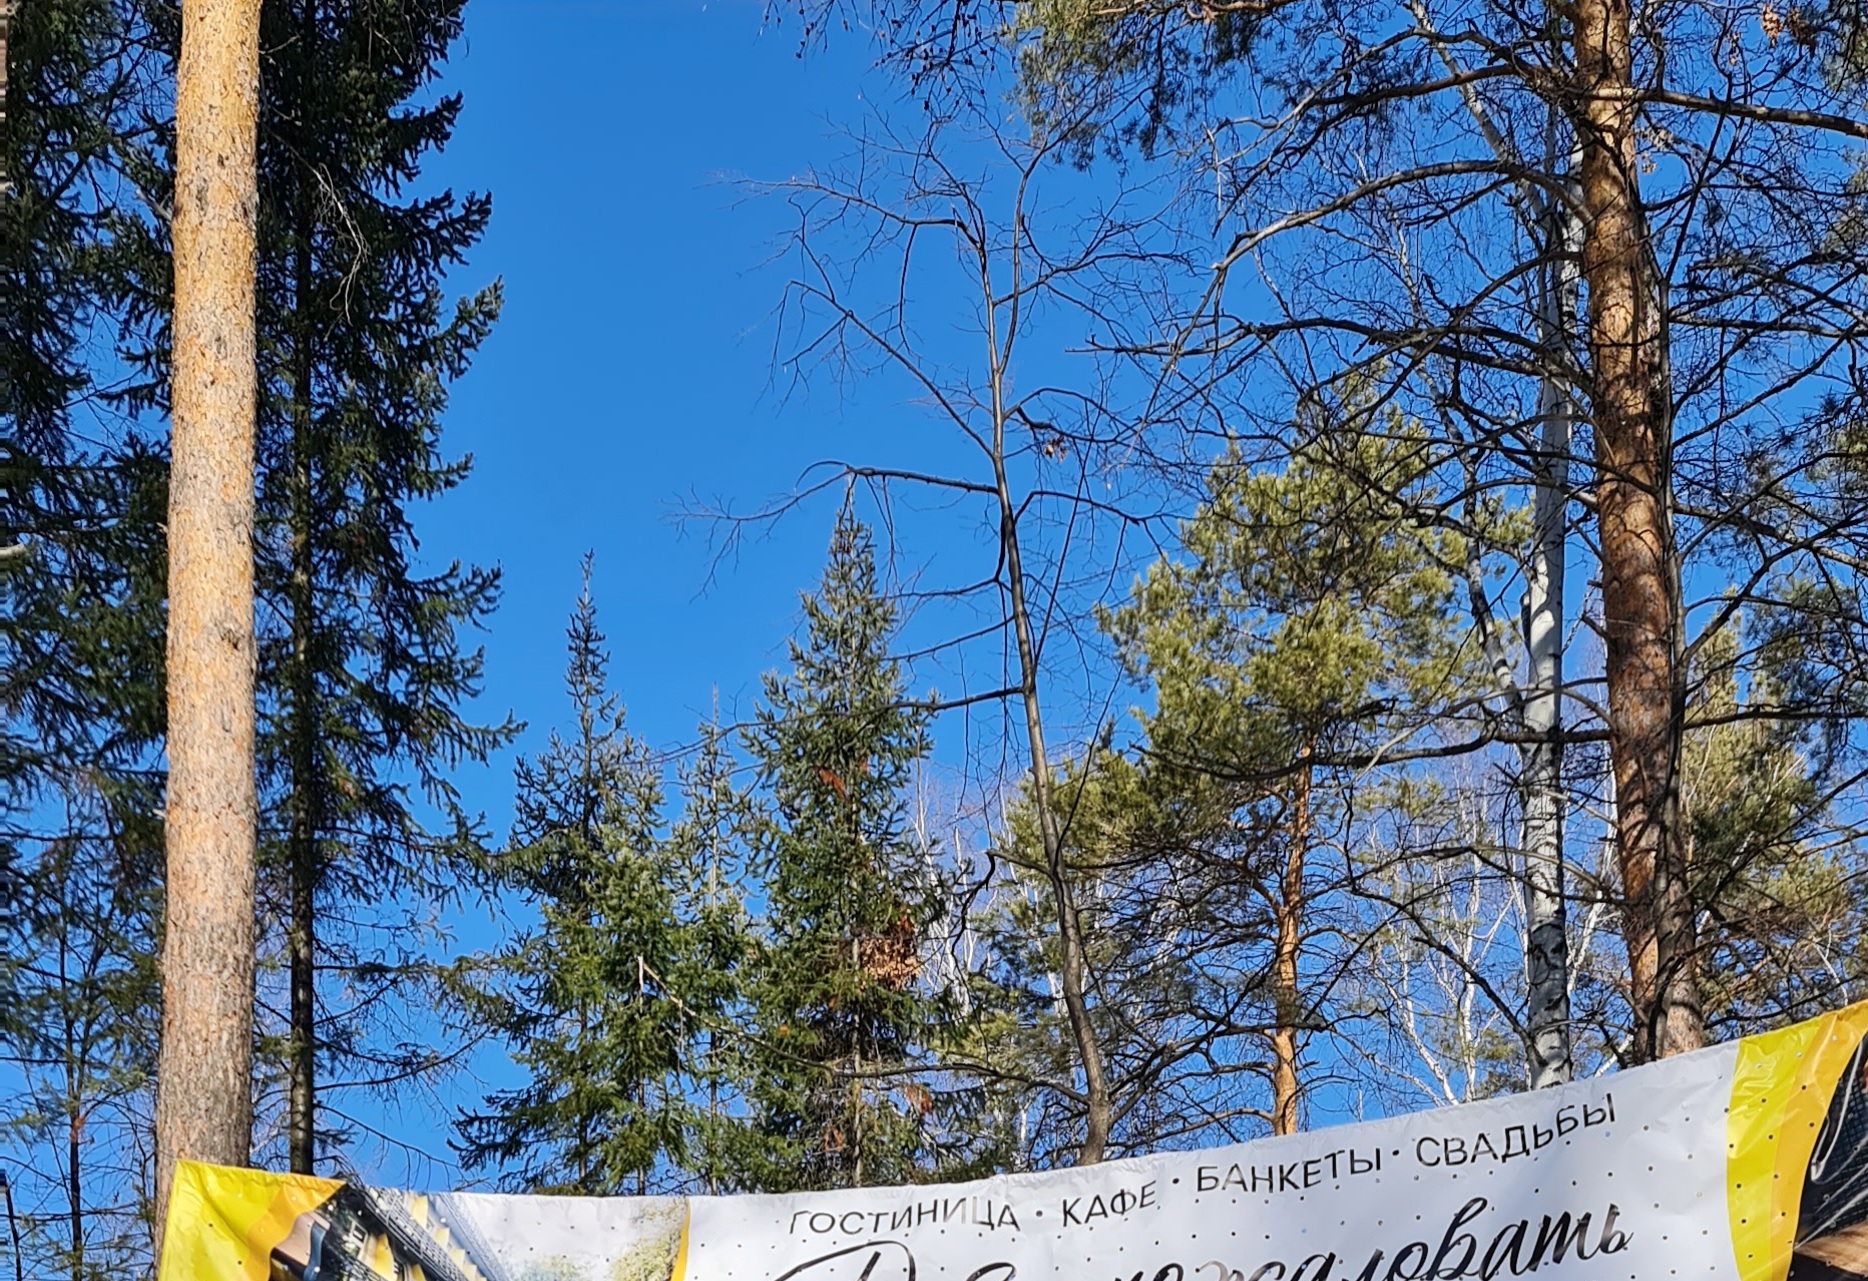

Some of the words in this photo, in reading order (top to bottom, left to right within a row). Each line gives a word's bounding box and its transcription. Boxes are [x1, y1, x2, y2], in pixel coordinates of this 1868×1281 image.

[789, 1197, 1021, 1234] ГОСТИНИЦА
[1061, 1180, 1157, 1227] КАФЕ
[1197, 1147, 1381, 1192] БАНКЕТЫ
[1415, 1093, 1616, 1167] СВАДЬБЫ
